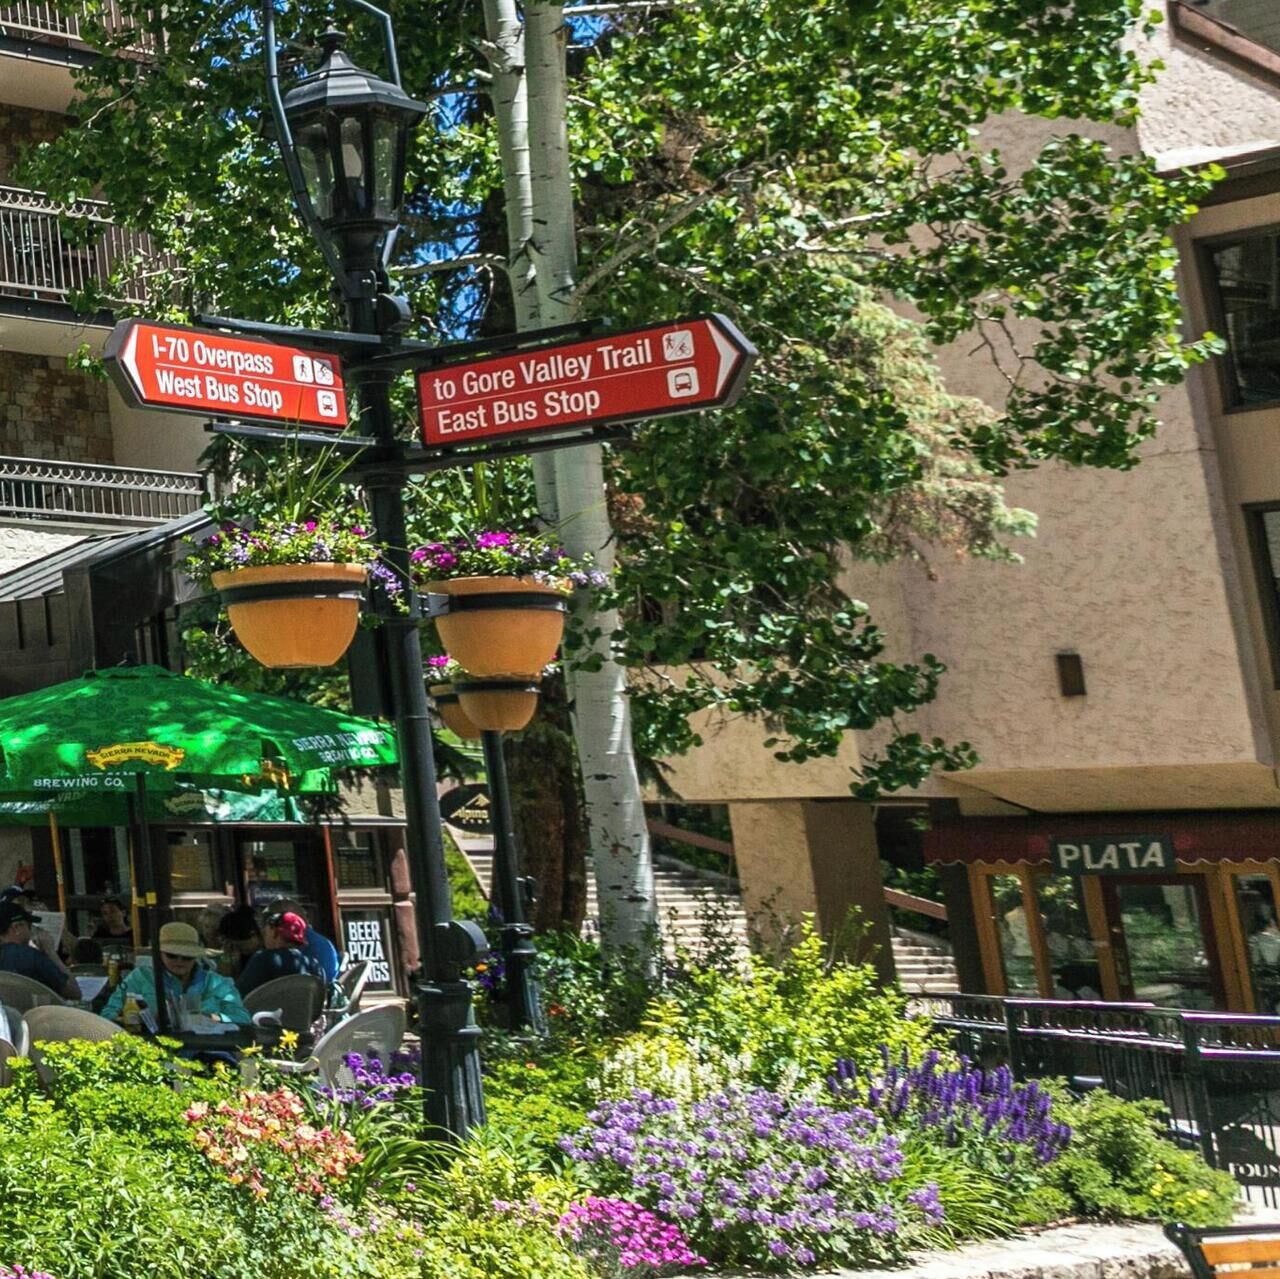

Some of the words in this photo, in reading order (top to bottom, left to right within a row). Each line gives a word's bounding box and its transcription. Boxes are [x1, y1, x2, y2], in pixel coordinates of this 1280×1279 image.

[151, 333, 189, 363] I-70
[193, 340, 274, 376] Overpass
[433, 377, 456, 401] to
[462, 365, 516, 397] Gore
[519, 353, 592, 384] Valley
[597, 338, 652, 371] Trail
[155, 369, 201, 400] West
[205, 377, 240, 404] Bus
[243, 381, 283, 412] Stop
[438, 407, 488, 435] East
[493, 399, 538, 426] Bus
[545, 389, 601, 418] Stop
[100, 747, 135, 760] SIERRA
[135, 747, 171, 760] NEVADA
[292, 734, 335, 752] SIERRA
[33, 776, 98, 788] BREWING
[1056, 841, 1166, 870] PLATA
[347, 921, 381, 941] BEER
[347, 941, 385, 961] PIZZA
